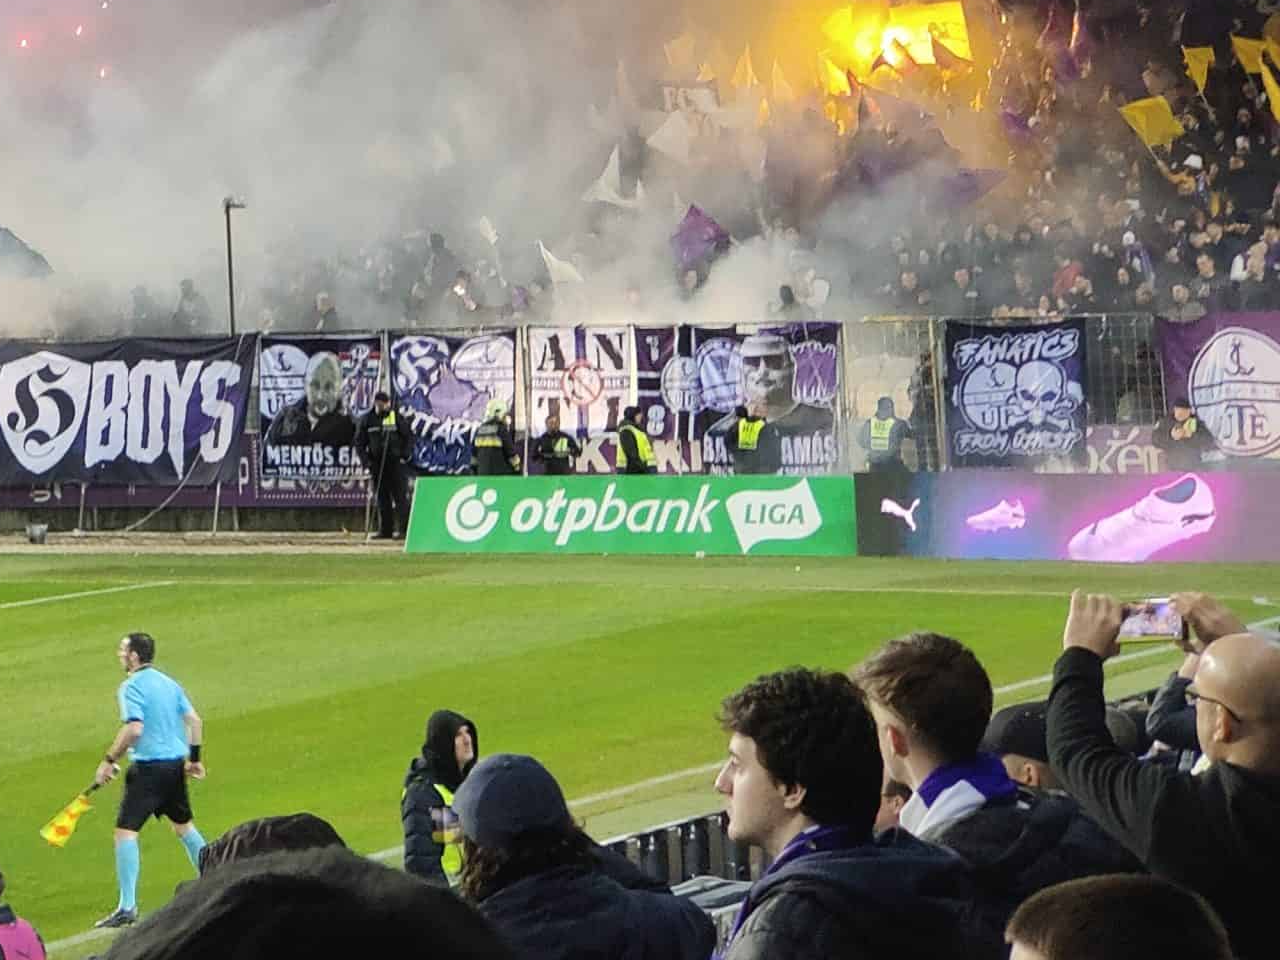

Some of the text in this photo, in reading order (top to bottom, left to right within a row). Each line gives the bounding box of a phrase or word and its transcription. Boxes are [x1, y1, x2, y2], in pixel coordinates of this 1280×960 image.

[955, 328, 1078, 368] FANATICS
[84, 359, 242, 481] BOYS
[509, 482, 805, 546] otpbank LIGA
